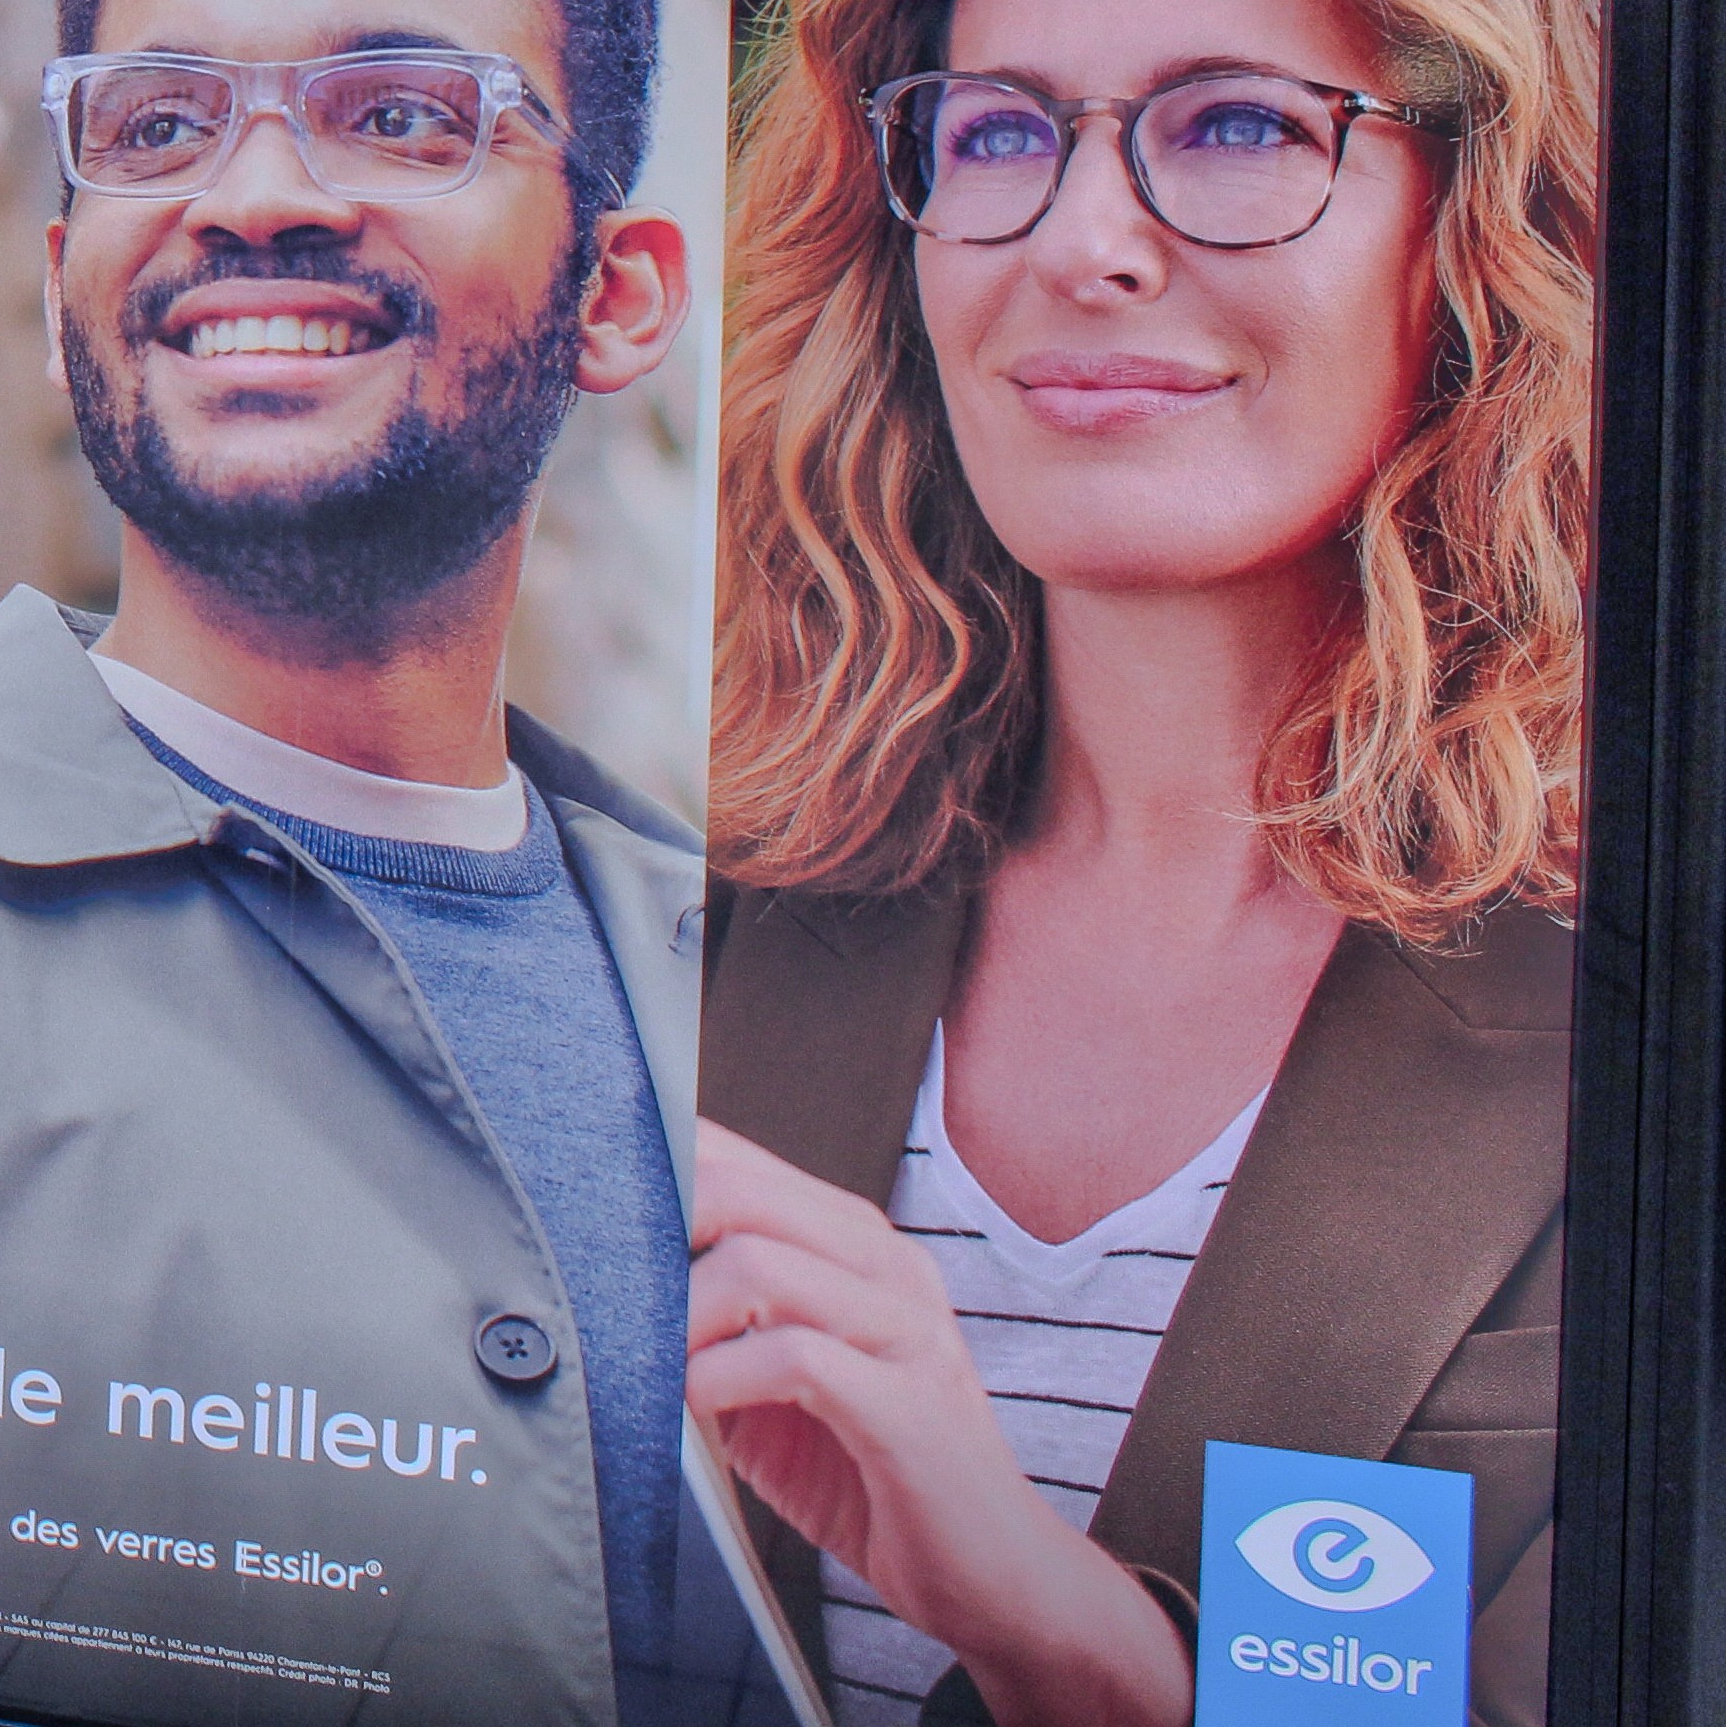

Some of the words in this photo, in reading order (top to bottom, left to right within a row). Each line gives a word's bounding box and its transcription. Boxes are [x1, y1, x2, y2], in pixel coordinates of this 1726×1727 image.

[107, 1380, 490, 1486] meilleur.
[9, 1508, 80, 1551] des
[94, 1525, 217, 1571] verres
[1229, 1632, 1433, 1696] essilor
